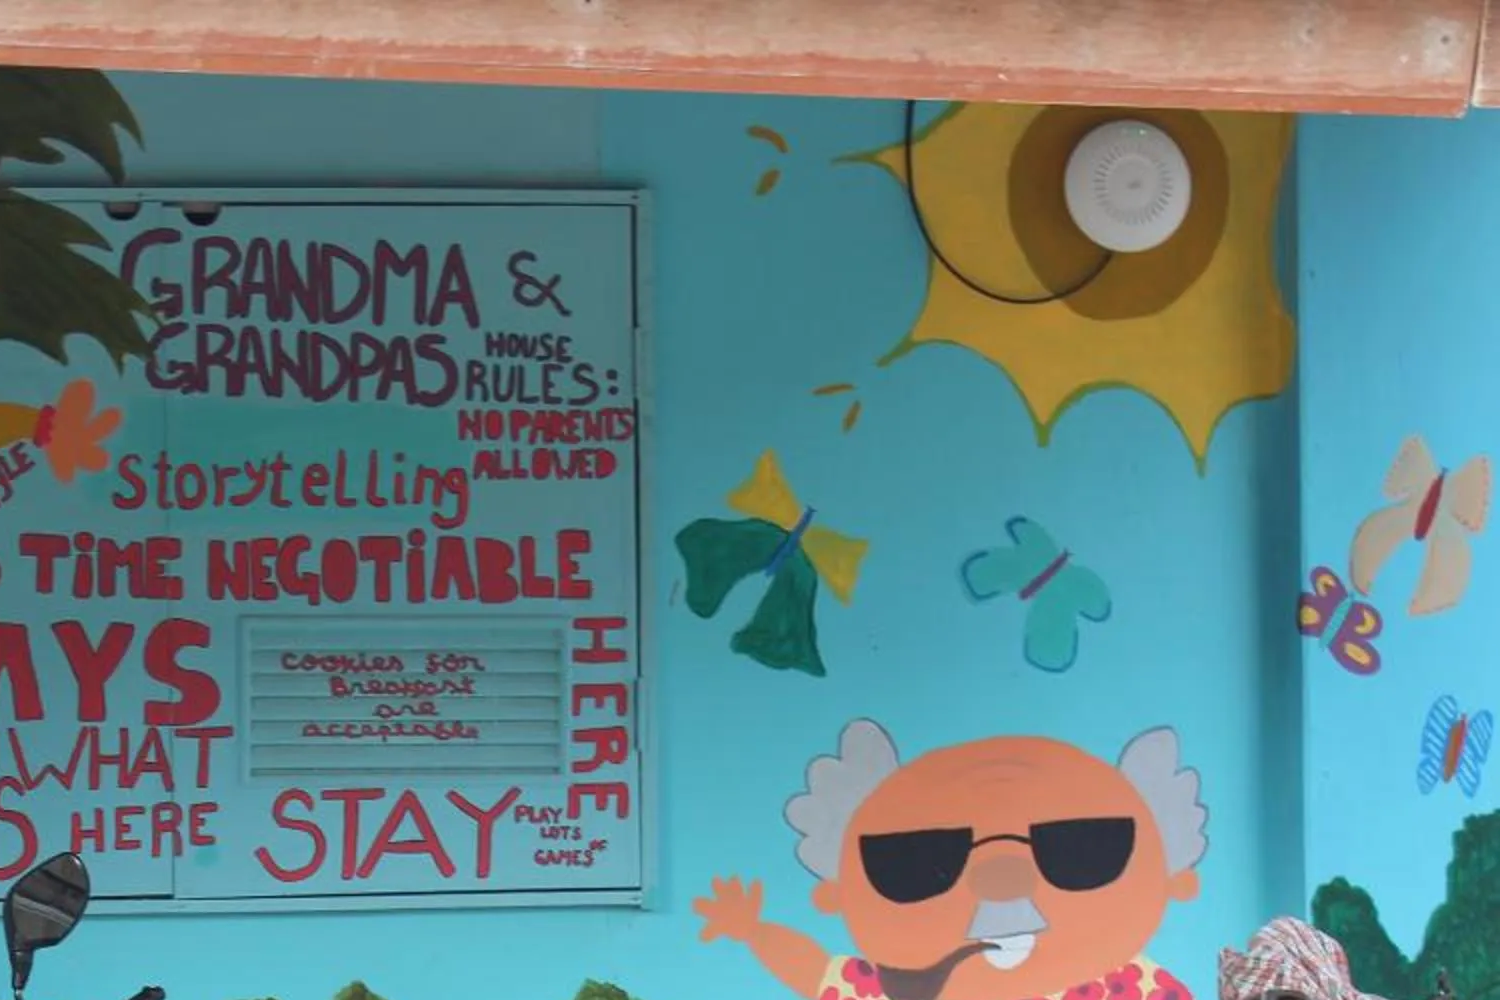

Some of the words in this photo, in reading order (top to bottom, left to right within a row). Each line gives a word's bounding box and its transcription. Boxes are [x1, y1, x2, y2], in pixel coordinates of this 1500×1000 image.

[121, 228, 480, 329] GRANDMA
[507, 250, 571, 316] &
[145, 323, 460, 407] GRANDPAS
[485, 331, 573, 363] HOUSE
[458, 408, 503, 441] NO
[509, 407, 635, 444] PARENTS
[472, 447, 617, 481] ALLOWED
[113, 447, 470, 529] Storytelling
[372, 701, 440, 718] are
[566, 616, 629, 820] HERE
[7, 726, 234, 791] WHAT
[514, 804, 563, 824] PLAY
[70, 802, 219, 857] HERE
[254, 786, 523, 882] STAY
[540, 826, 582, 841] LOTS
[534, 848, 595, 869] GAMES
